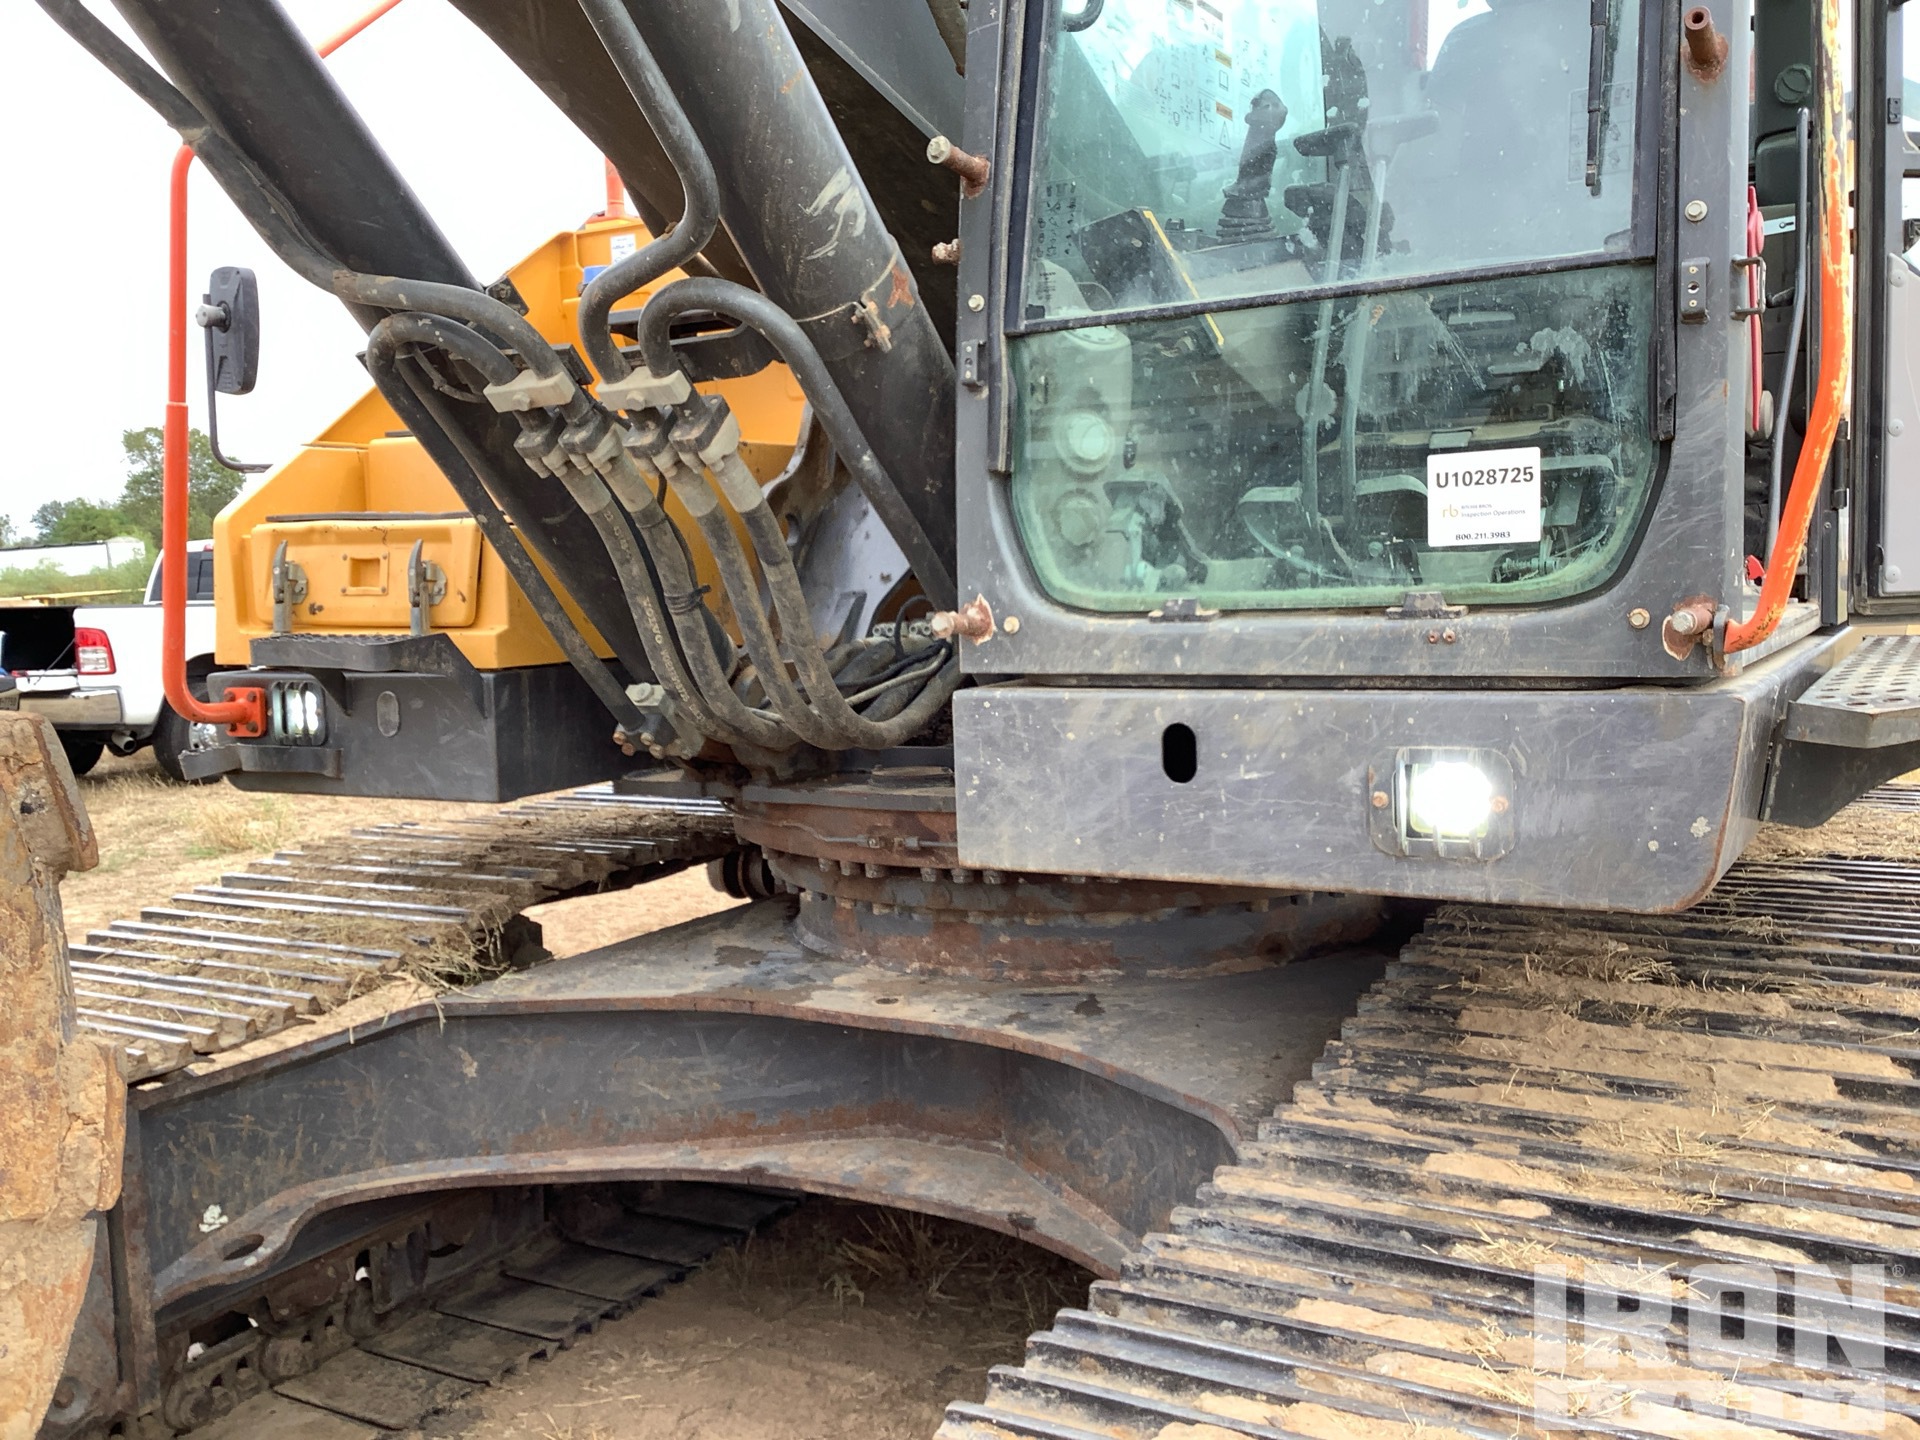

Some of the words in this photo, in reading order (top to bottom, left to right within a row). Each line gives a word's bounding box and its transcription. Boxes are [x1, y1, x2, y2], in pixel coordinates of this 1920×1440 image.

[1436, 466, 1534, 488] U1028725
[1493, 508, 1526, 516] Operations
[1455, 531, 1511, 541] 800.211.3983
